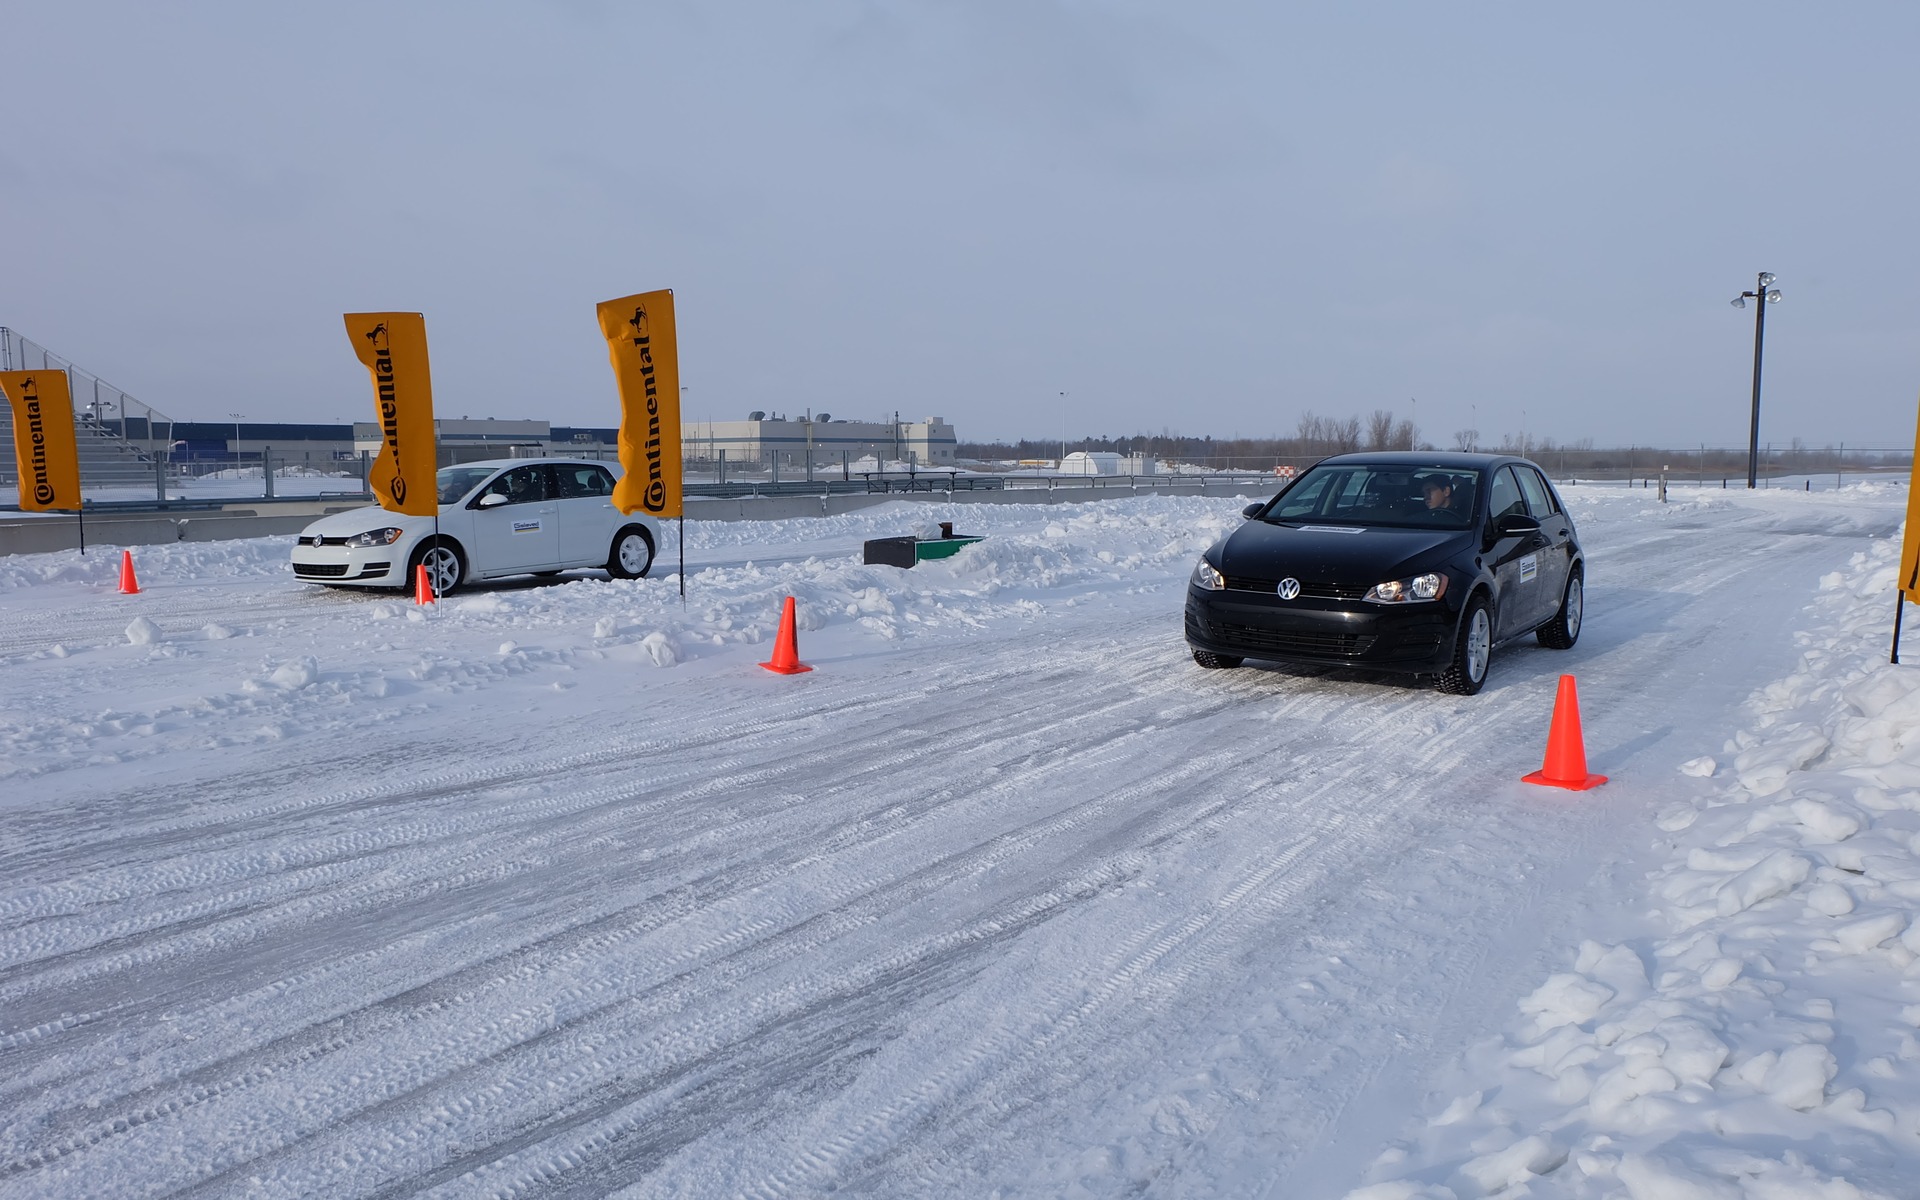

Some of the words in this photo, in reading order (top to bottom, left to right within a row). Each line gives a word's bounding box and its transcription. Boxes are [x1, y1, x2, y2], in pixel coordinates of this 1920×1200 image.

[23, 394, 55, 505] Continental
[375, 348, 407, 506] Cnental
[634, 334, 666, 512] Continental
[1278, 577, 1300, 600] VW
